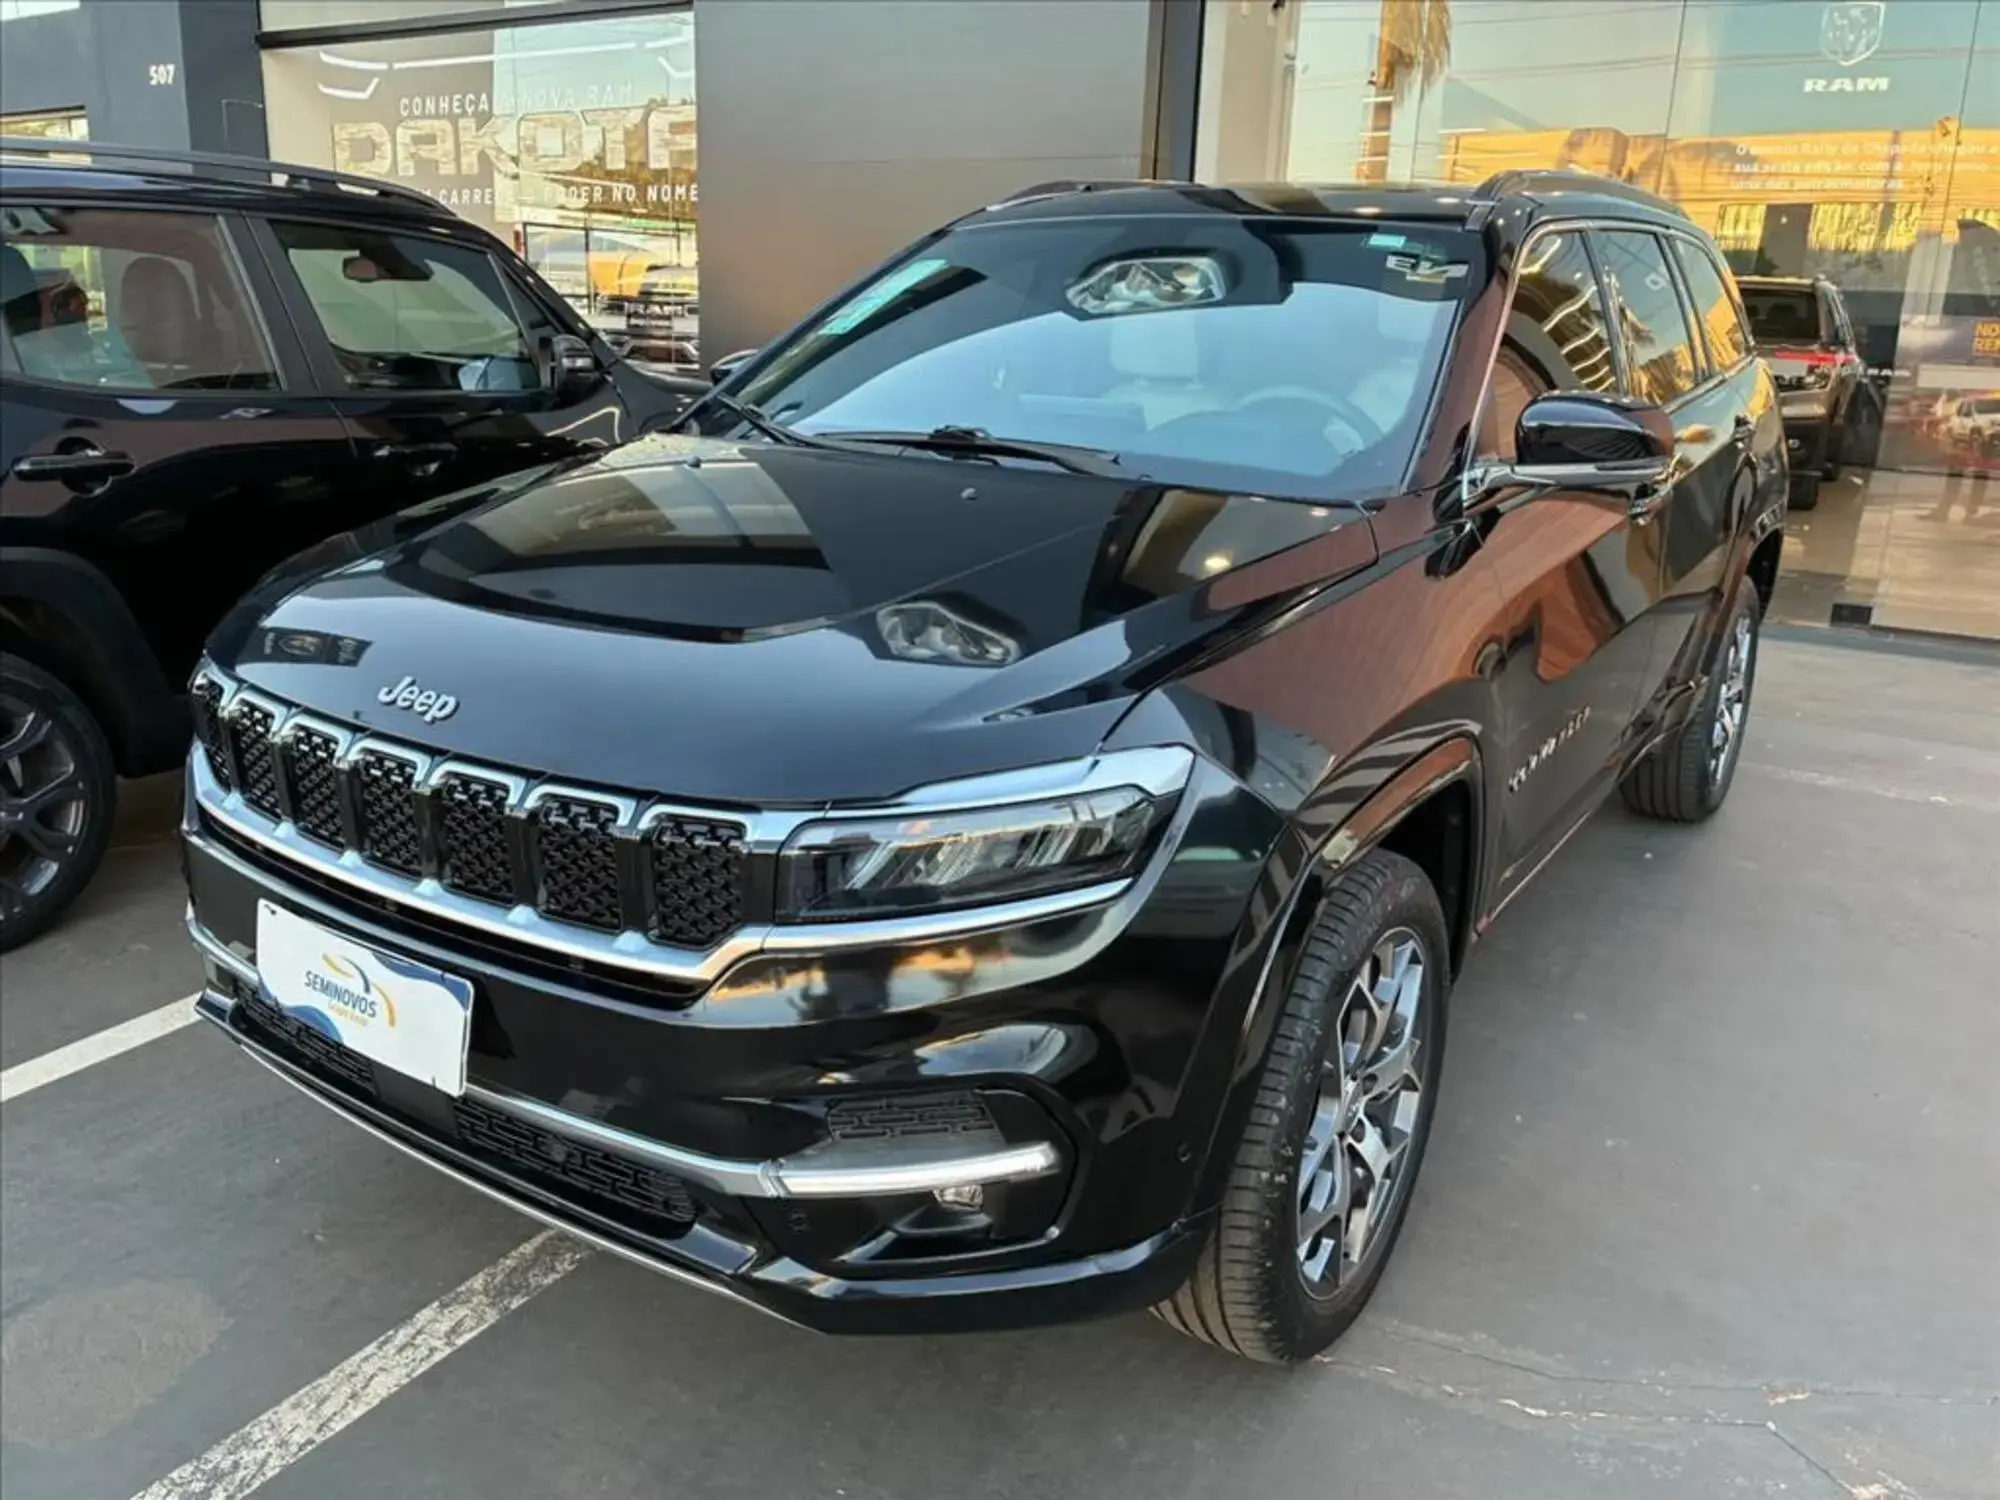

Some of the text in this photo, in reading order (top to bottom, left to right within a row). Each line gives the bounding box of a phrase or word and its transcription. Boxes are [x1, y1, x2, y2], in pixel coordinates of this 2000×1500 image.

[149, 63, 175, 86] 507
[1803, 77, 1889, 92] RAM
[400, 92, 489, 117] CONHEÇA
[331, 104, 698, 177] DAKOTA
[612, 182, 636, 201] NO
[647, 182, 699, 203] NOME
[377, 675, 458, 723] Jeep
[304, 970, 377, 1018] SEMINOVOS
